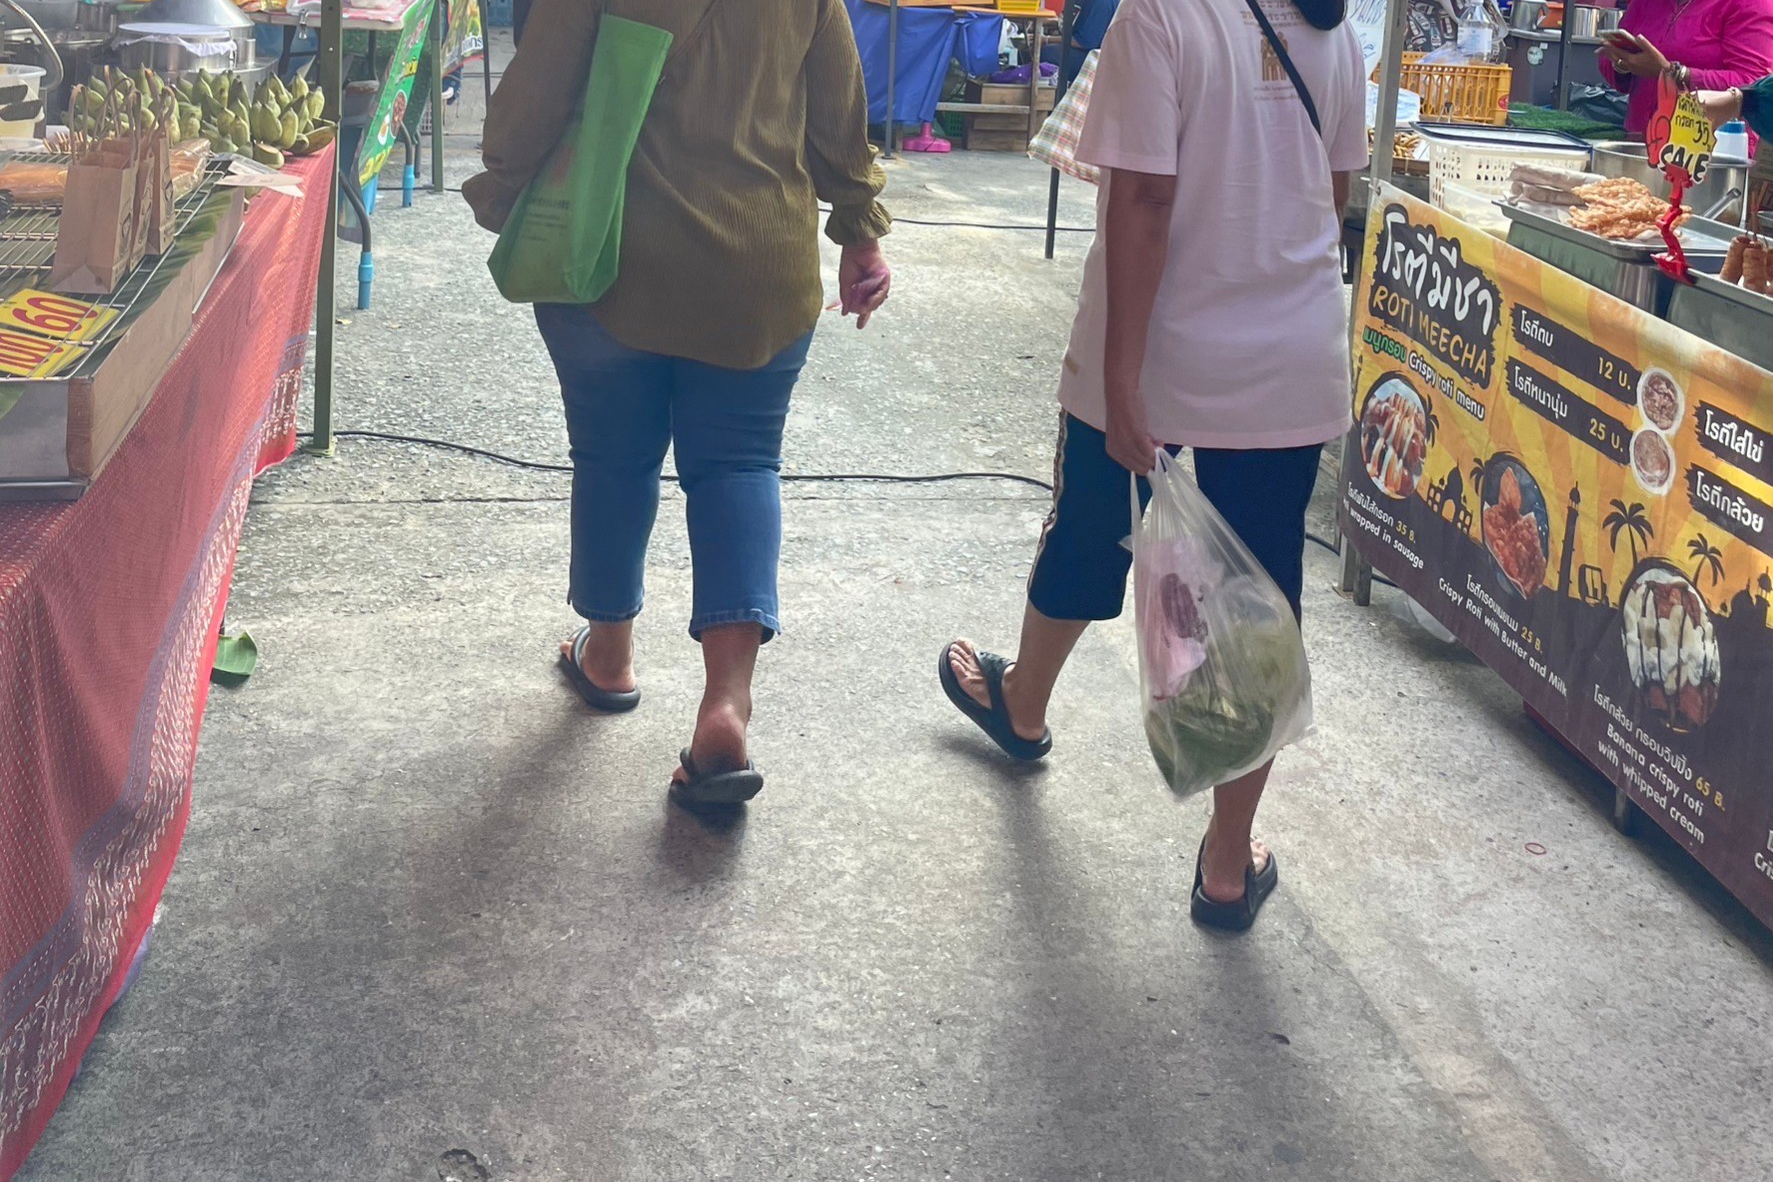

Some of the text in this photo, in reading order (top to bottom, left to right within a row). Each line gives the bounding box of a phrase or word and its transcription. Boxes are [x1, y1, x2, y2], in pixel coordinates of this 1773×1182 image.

[1693, 120, 1710, 146] 35
[1381, 211, 1495, 336] โรตีมีชา
[12, 296, 98, 333] 60
[1372, 285, 1487, 380] ROTI MEECHA
[1409, 352, 1437, 387] Crispy
[1438, 373, 1454, 398] roti
[1456, 386, 1486, 420] menu
[1598, 356, 1613, 380] 12
[1617, 370, 1631, 391] บ.
[1514, 365, 1624, 453] โรตีหนานุ่ม 25 บ.
[1704, 409, 1765, 464] โรตีใส่ไข่
[1395, 520, 1408, 535] 35
[1695, 470, 1765, 534] โรตีกล้วย
[1350, 506, 1424, 570] wrapped in sausage
[1438, 577, 1568, 698] Crispy Roti with Butter and Milk
[1520, 625, 1533, 644] 25
[1534, 637, 1544, 654] B.
[1593, 683, 1633, 732] โรตีกล้วย
[1695, 775, 1711, 797] 65
[1713, 790, 1727, 812] B.
[1606, 722, 1705, 818] Banana crispy roti
[1597, 738, 1705, 845] with whipped cream
